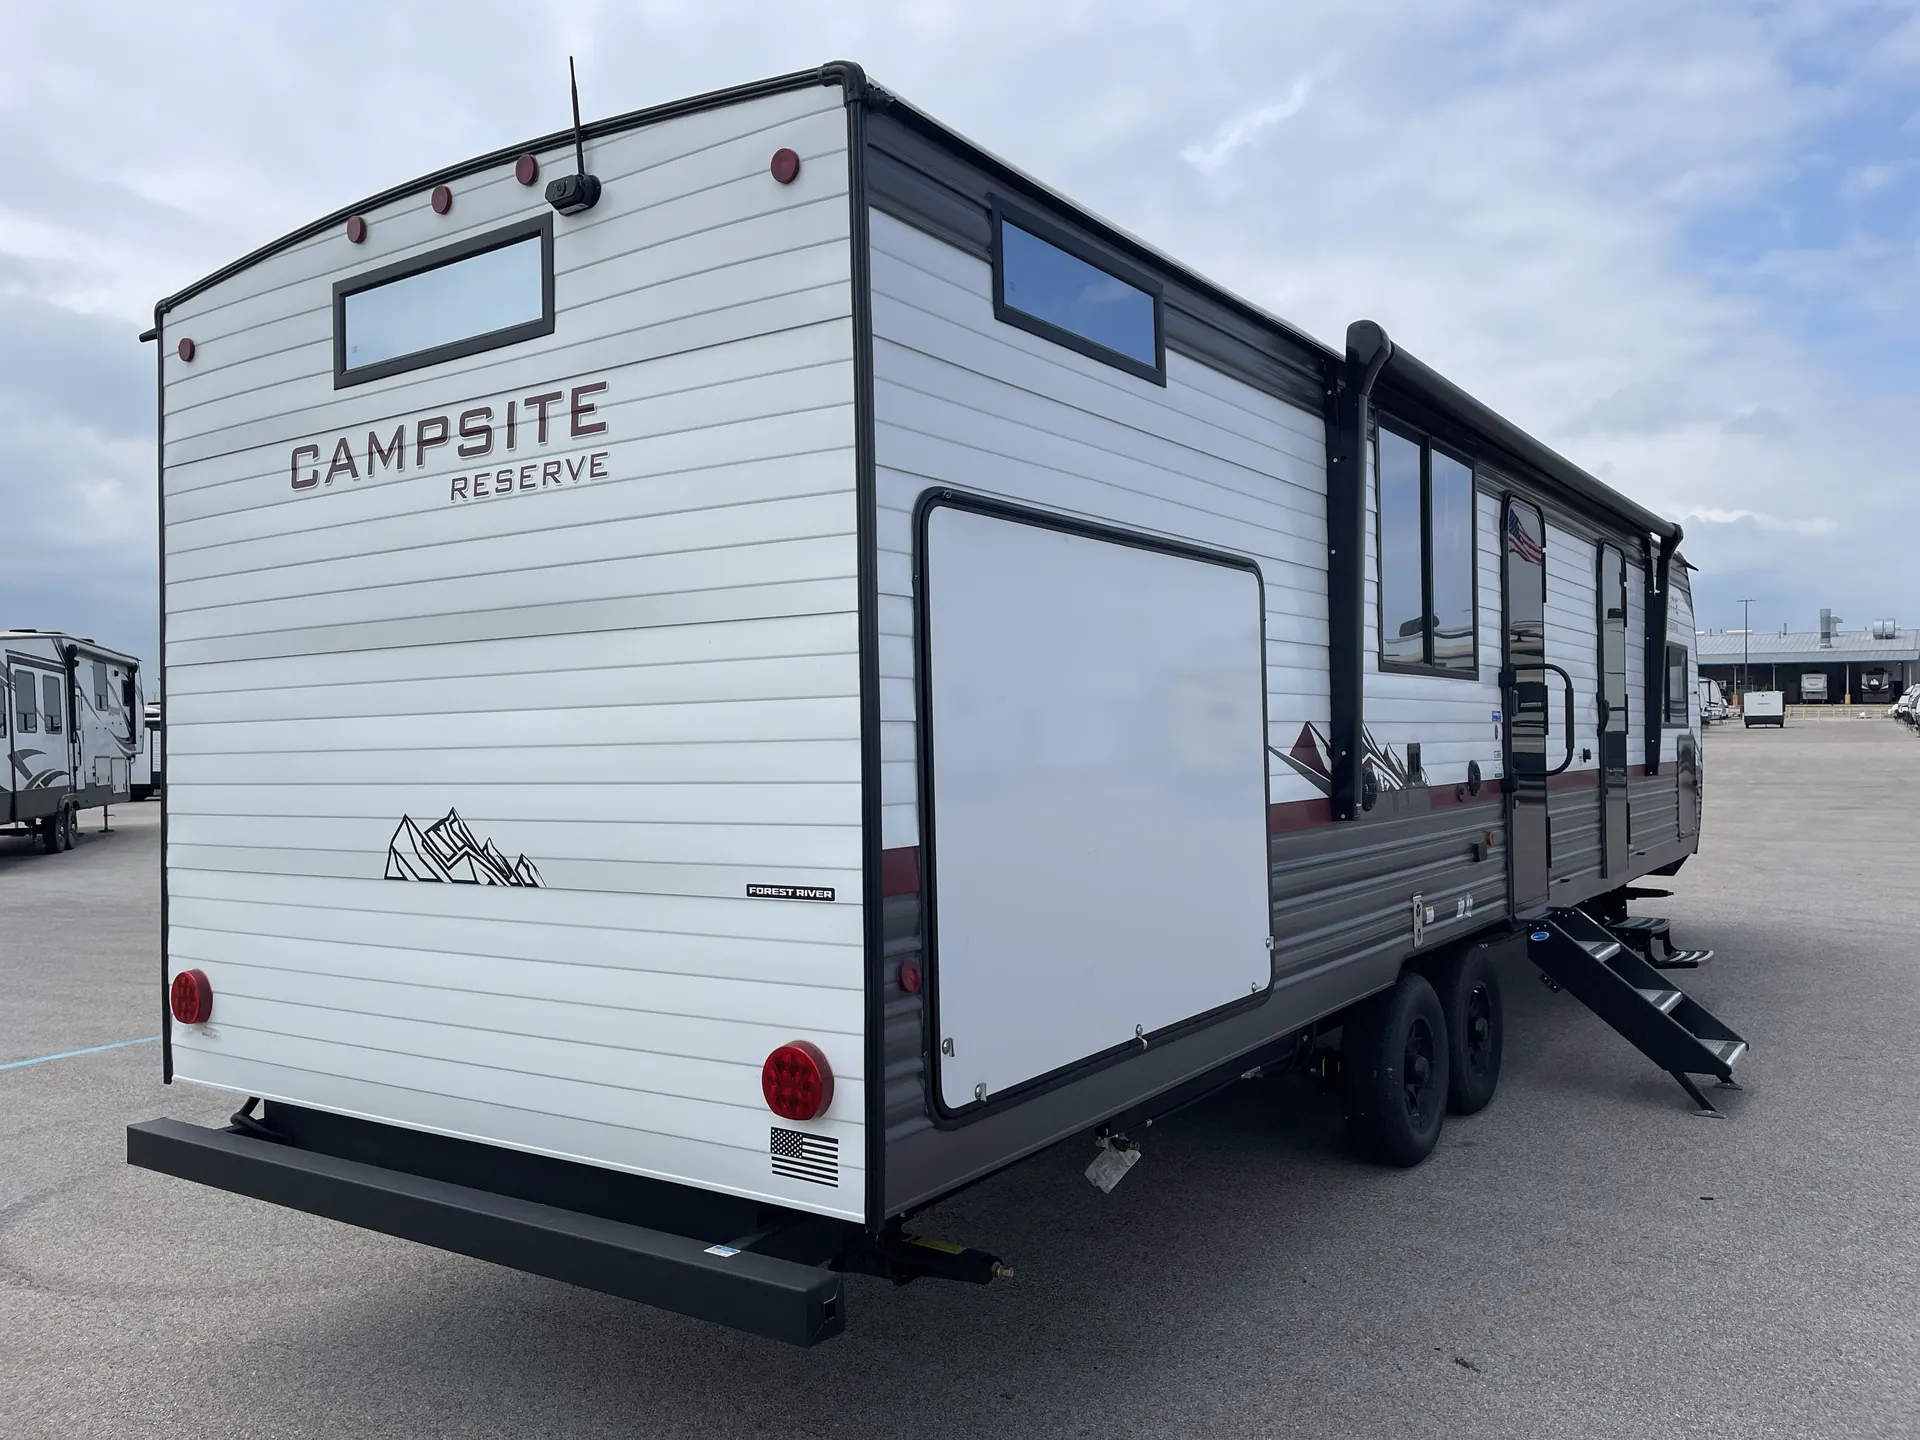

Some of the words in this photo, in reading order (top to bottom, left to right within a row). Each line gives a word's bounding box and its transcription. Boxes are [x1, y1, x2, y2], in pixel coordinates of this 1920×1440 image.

[291, 381, 607, 489] CAMPSITE
[451, 452, 608, 501] RESERVE
[748, 886, 794, 896] FOREST
[796, 888, 832, 898] RIVER
